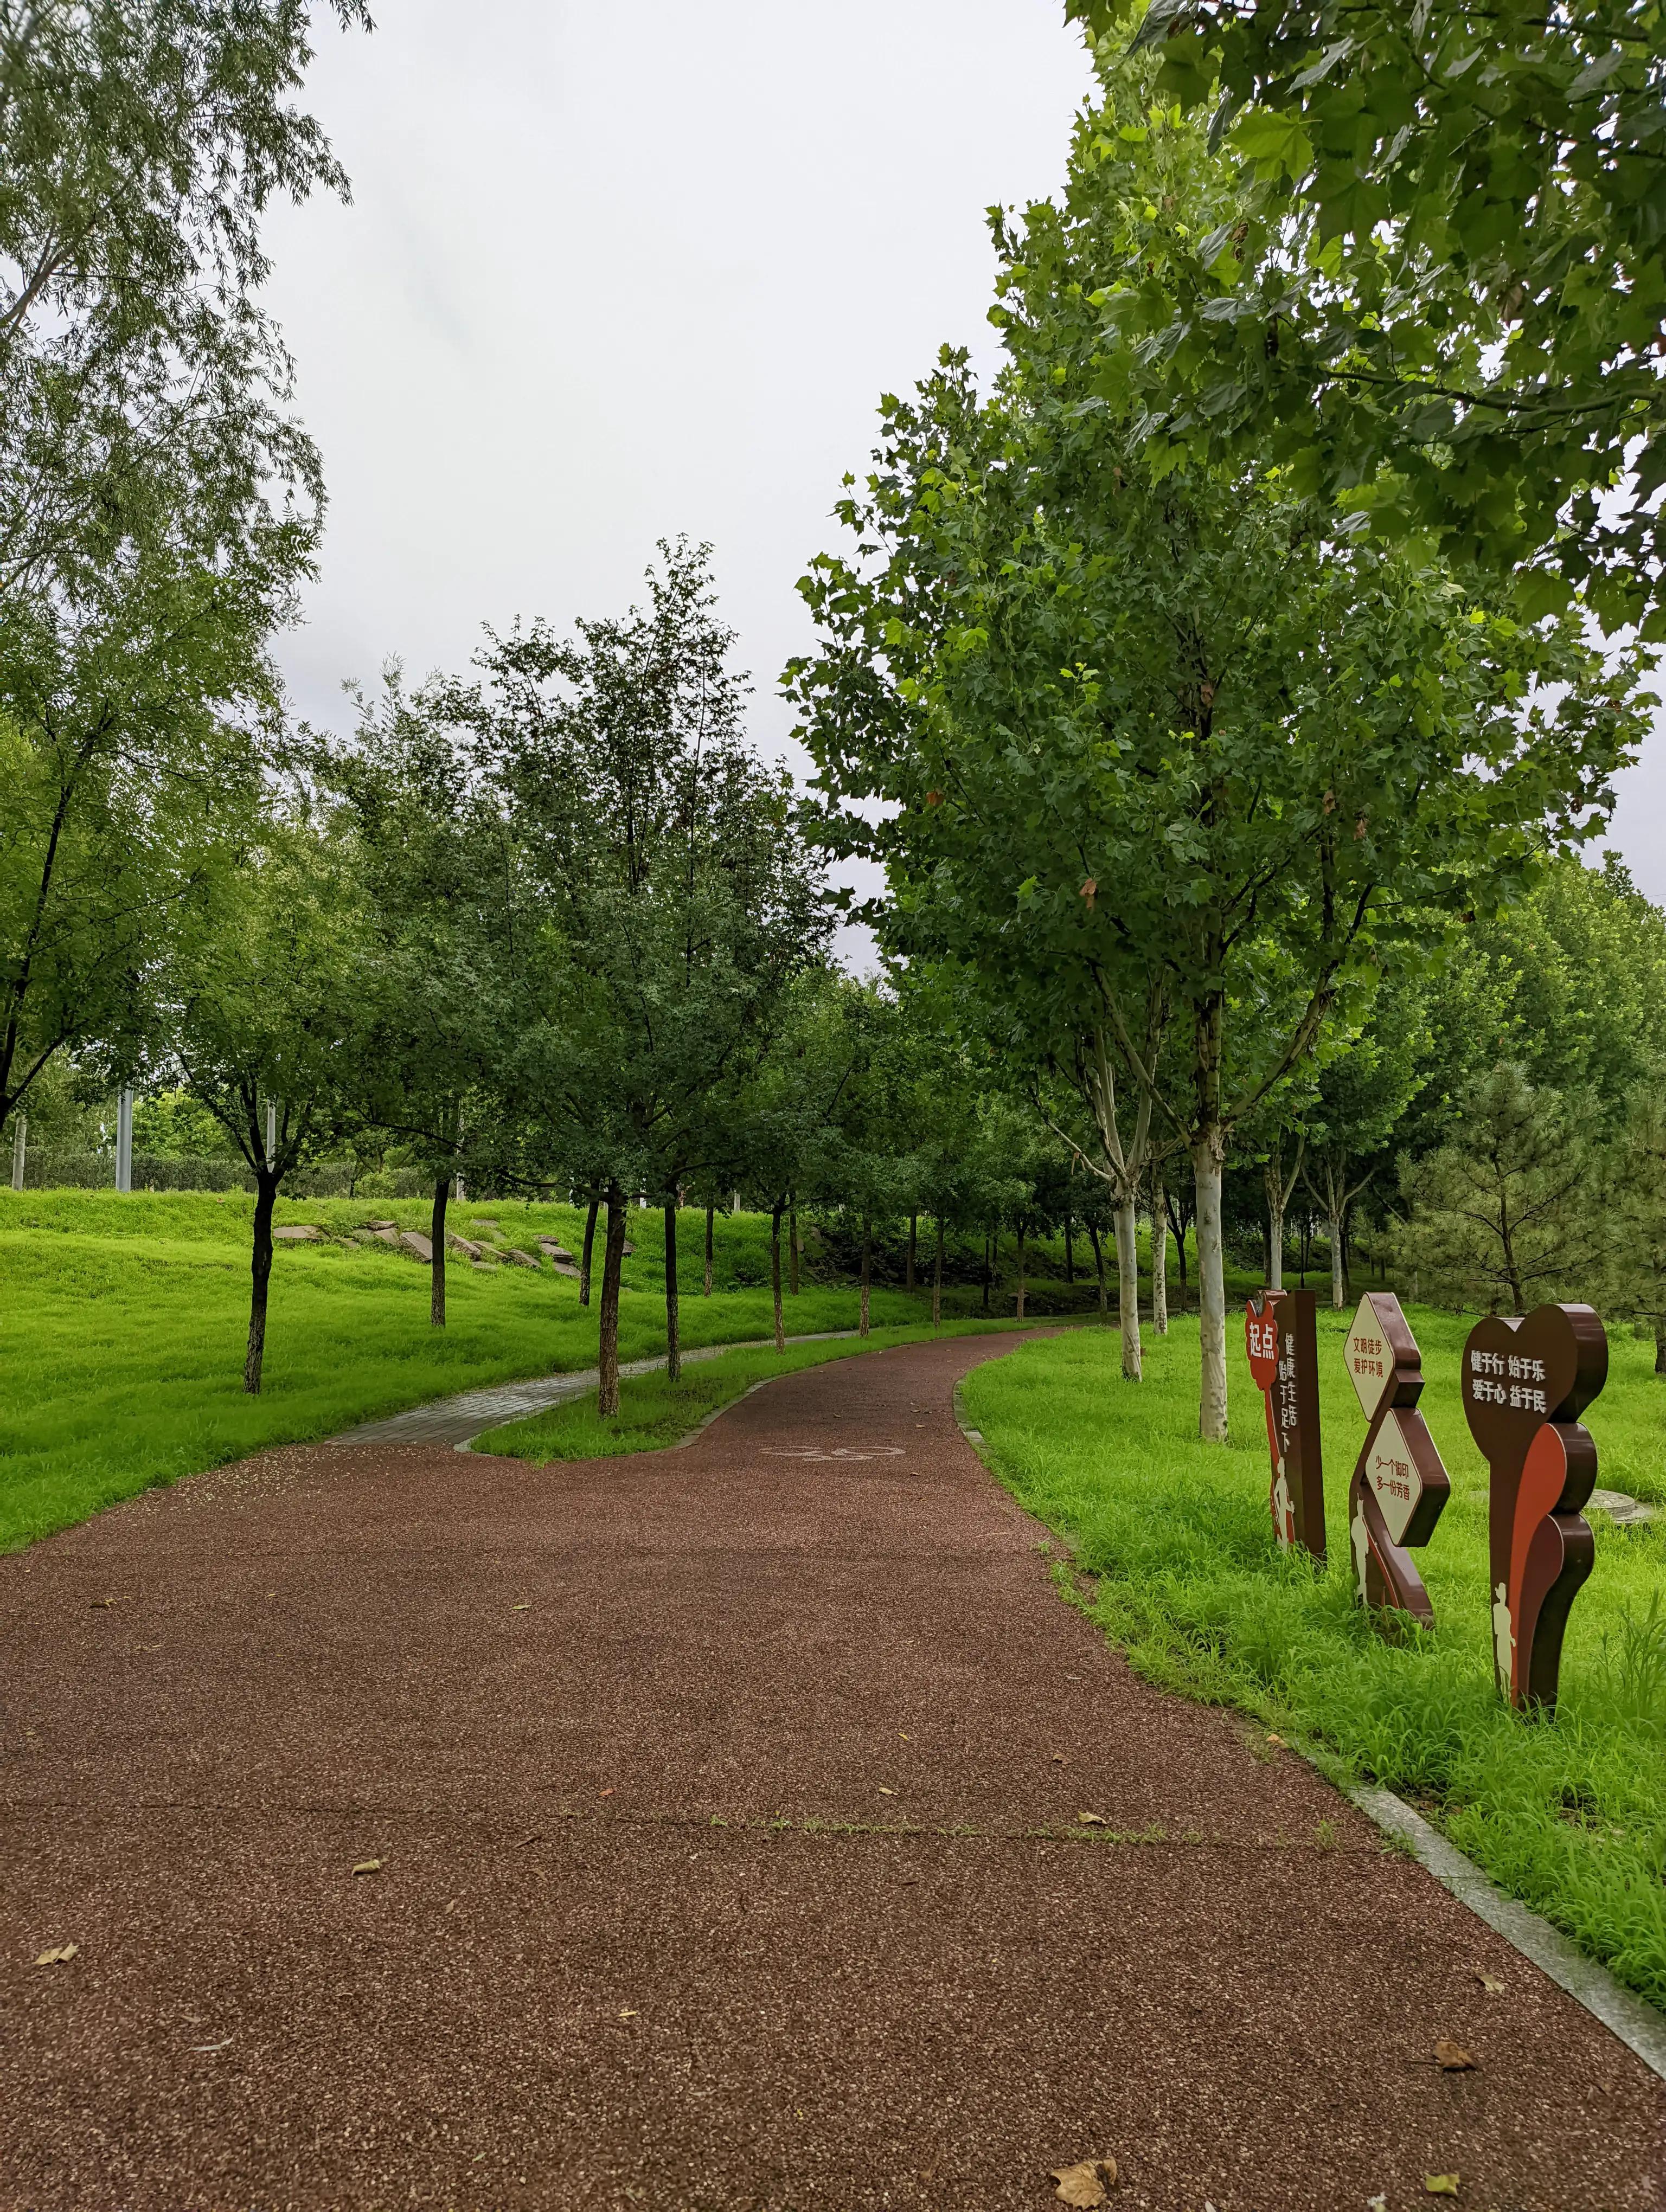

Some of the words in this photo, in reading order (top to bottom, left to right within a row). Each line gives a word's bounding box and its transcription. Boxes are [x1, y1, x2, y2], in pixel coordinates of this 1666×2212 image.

[1250, 1322, 1274, 1359] 起点
[1353, 1337, 1382, 1355] 文明徒步
[1285, 1333, 1297, 1426] 健康生活
[1354, 1358, 1383, 1378] 爱护环境
[1471, 1350, 1505, 1375] 健于行
[1508, 1355, 1546, 1381] 始于乐
[1278, 1360, 1291, 1452] 始于足下
[1472, 1379, 1507, 1404] 爱于心
[1510, 1385, 1547, 1414] 益于民
[1375, 1455, 1409, 1479] 少一个脚印
[1376, 1475, 1410, 1501] 多一份芳香
